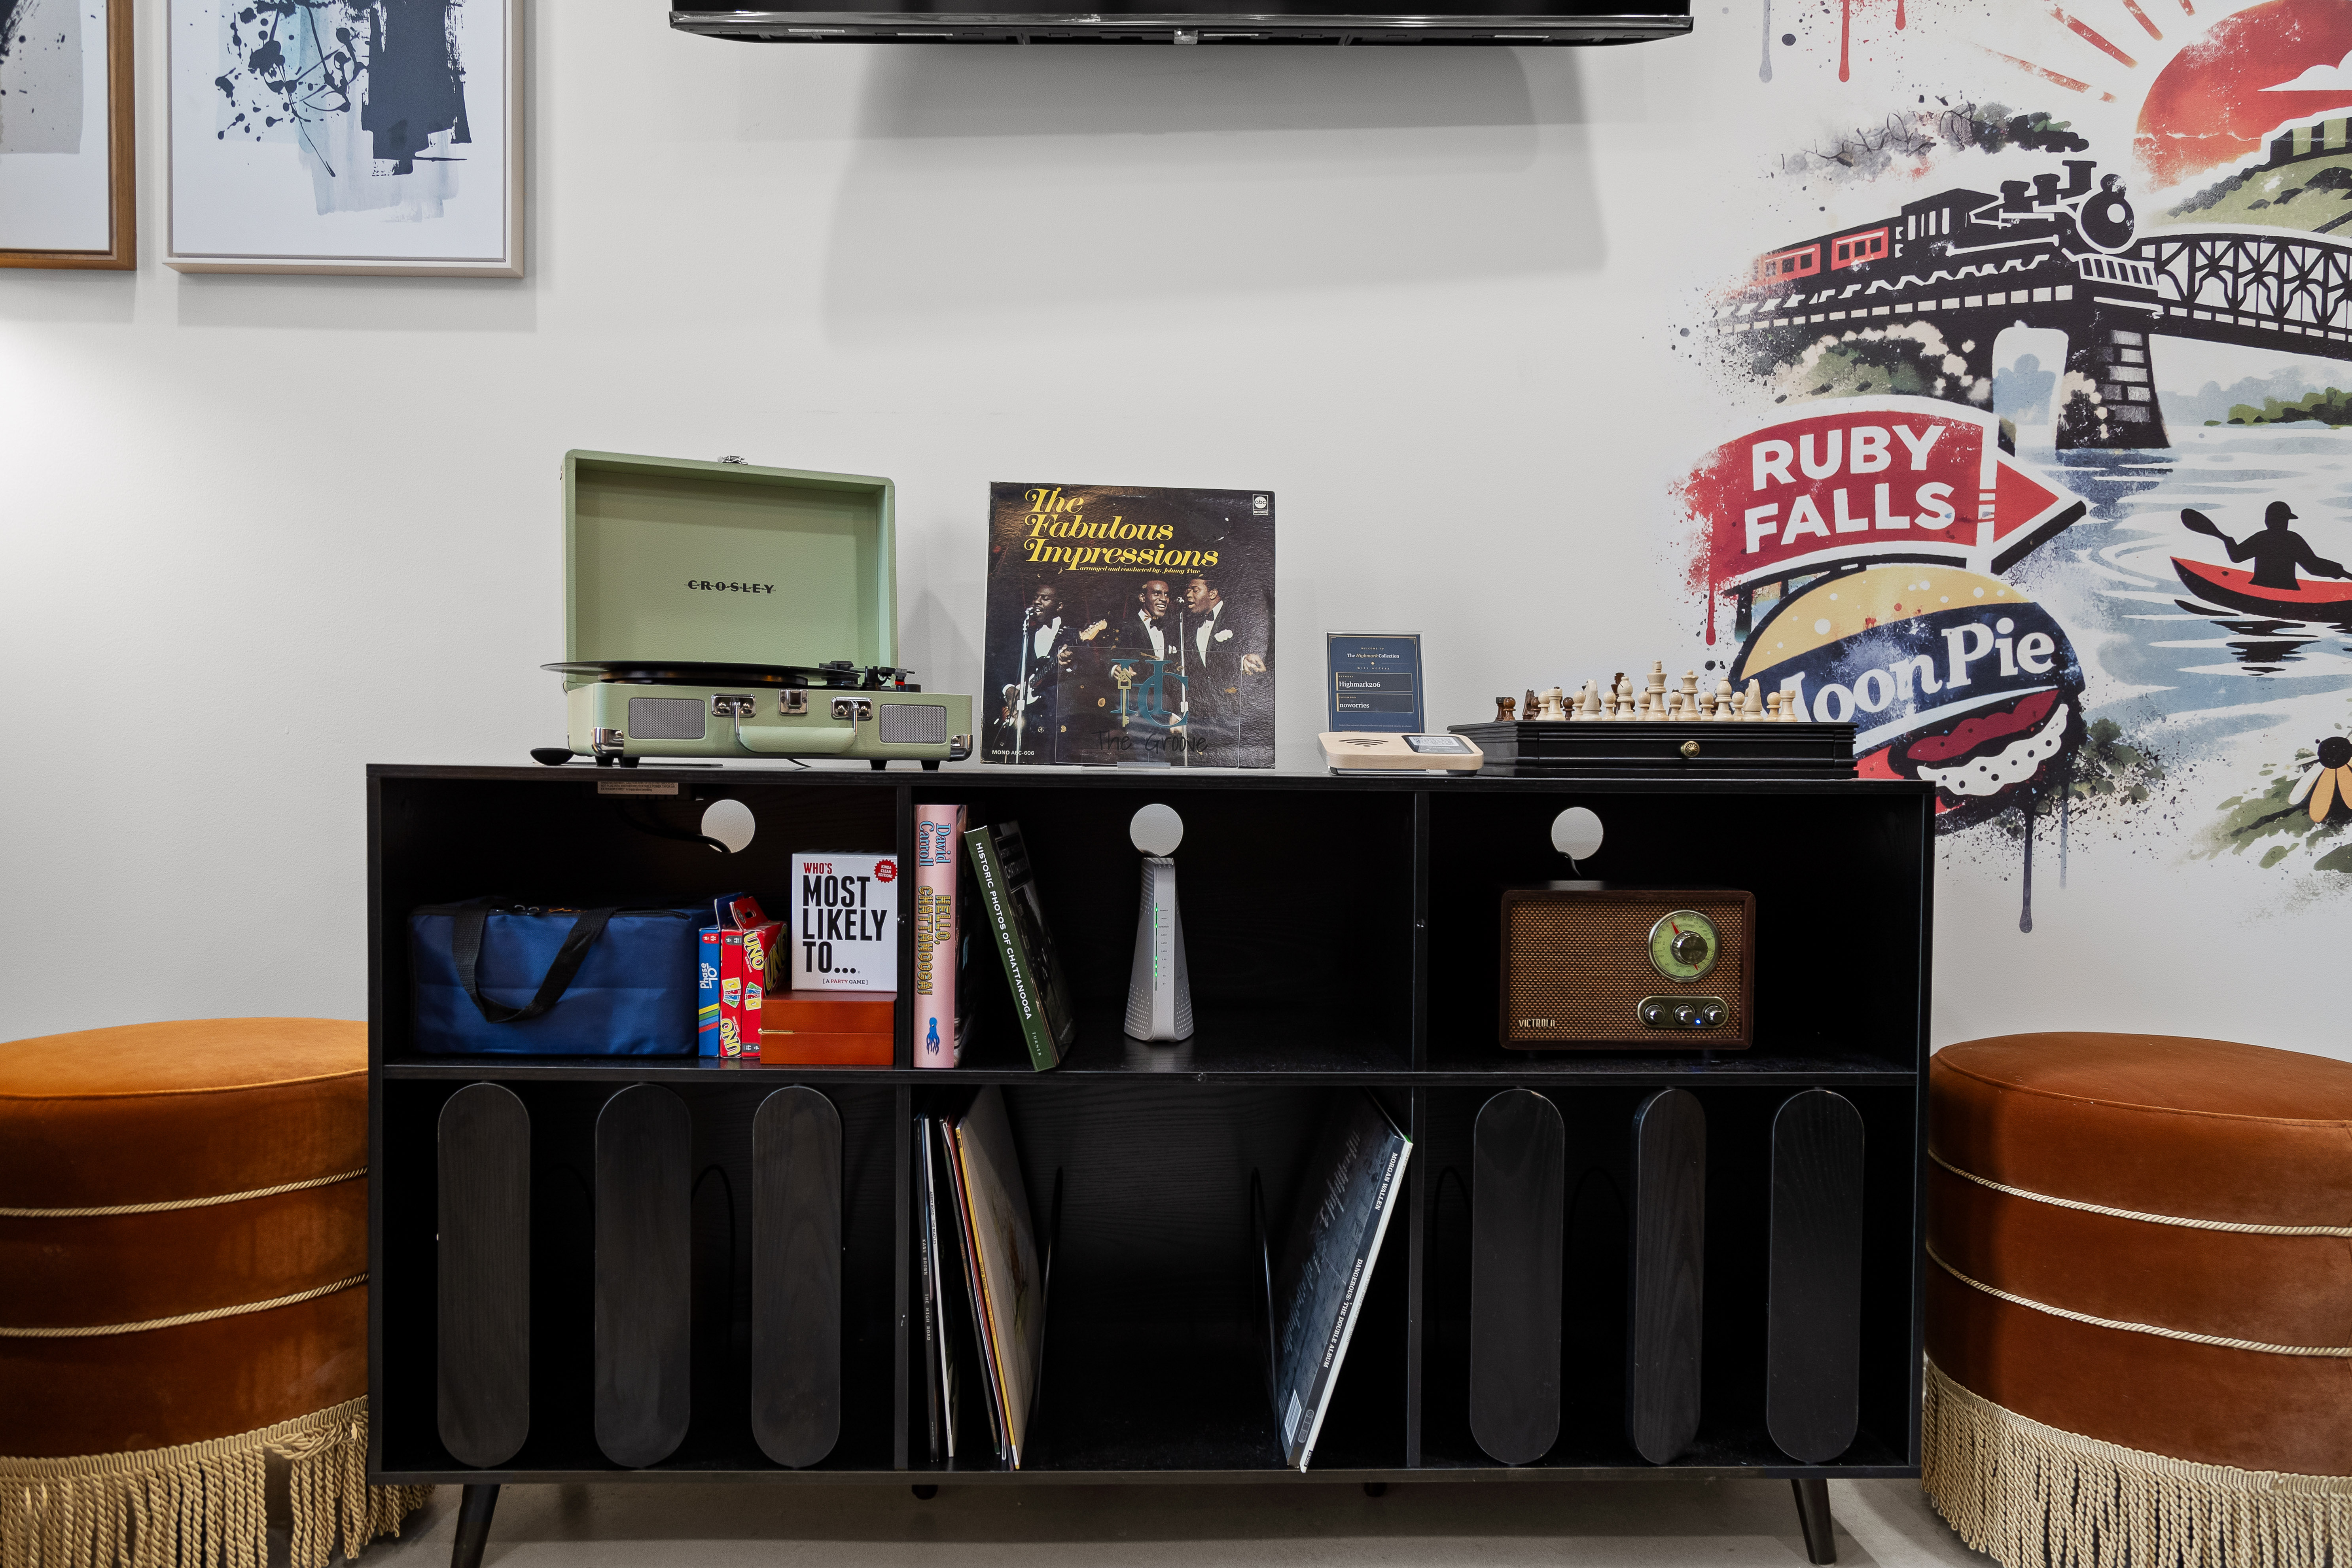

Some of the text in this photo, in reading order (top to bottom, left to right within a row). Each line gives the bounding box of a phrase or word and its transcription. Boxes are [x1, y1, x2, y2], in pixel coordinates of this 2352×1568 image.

[1752, 424, 1946, 491] RUBY
[1025, 487, 1084, 513] The
[1744, 482, 1956, 554] FALLS
[1024, 514, 1174, 541] Fabulous
[1024, 538, 1219, 571] Impressions
[686, 580, 775, 594] CROSLEY
[1091, 730, 1208, 752] The Groove
[919, 821, 934, 867] Carroll
[936, 823, 951, 864] David
[803, 862, 832, 874] WHO'S
[803, 875, 871, 908] MOST
[803, 908, 888, 941] LIKELY
[934, 895, 951, 945] HELLO,
[976, 843, 1032, 1019] HISTORIC PHOTOS OF CHATTANOOGA
[744, 931, 764, 970] UNO
[803, 941, 856, 973] TO...
[917, 886, 934, 995] CHATTANOOGA!
[700, 963, 709, 989] Phase
[707, 968, 718, 981] 10
[720, 1018, 741, 1057] UNO
[1375, 1152, 1398, 1211] MORGAN WALLEN
[1323, 1258, 1363, 1368] DANGEROUS: THE DOUBLE ALBUM
